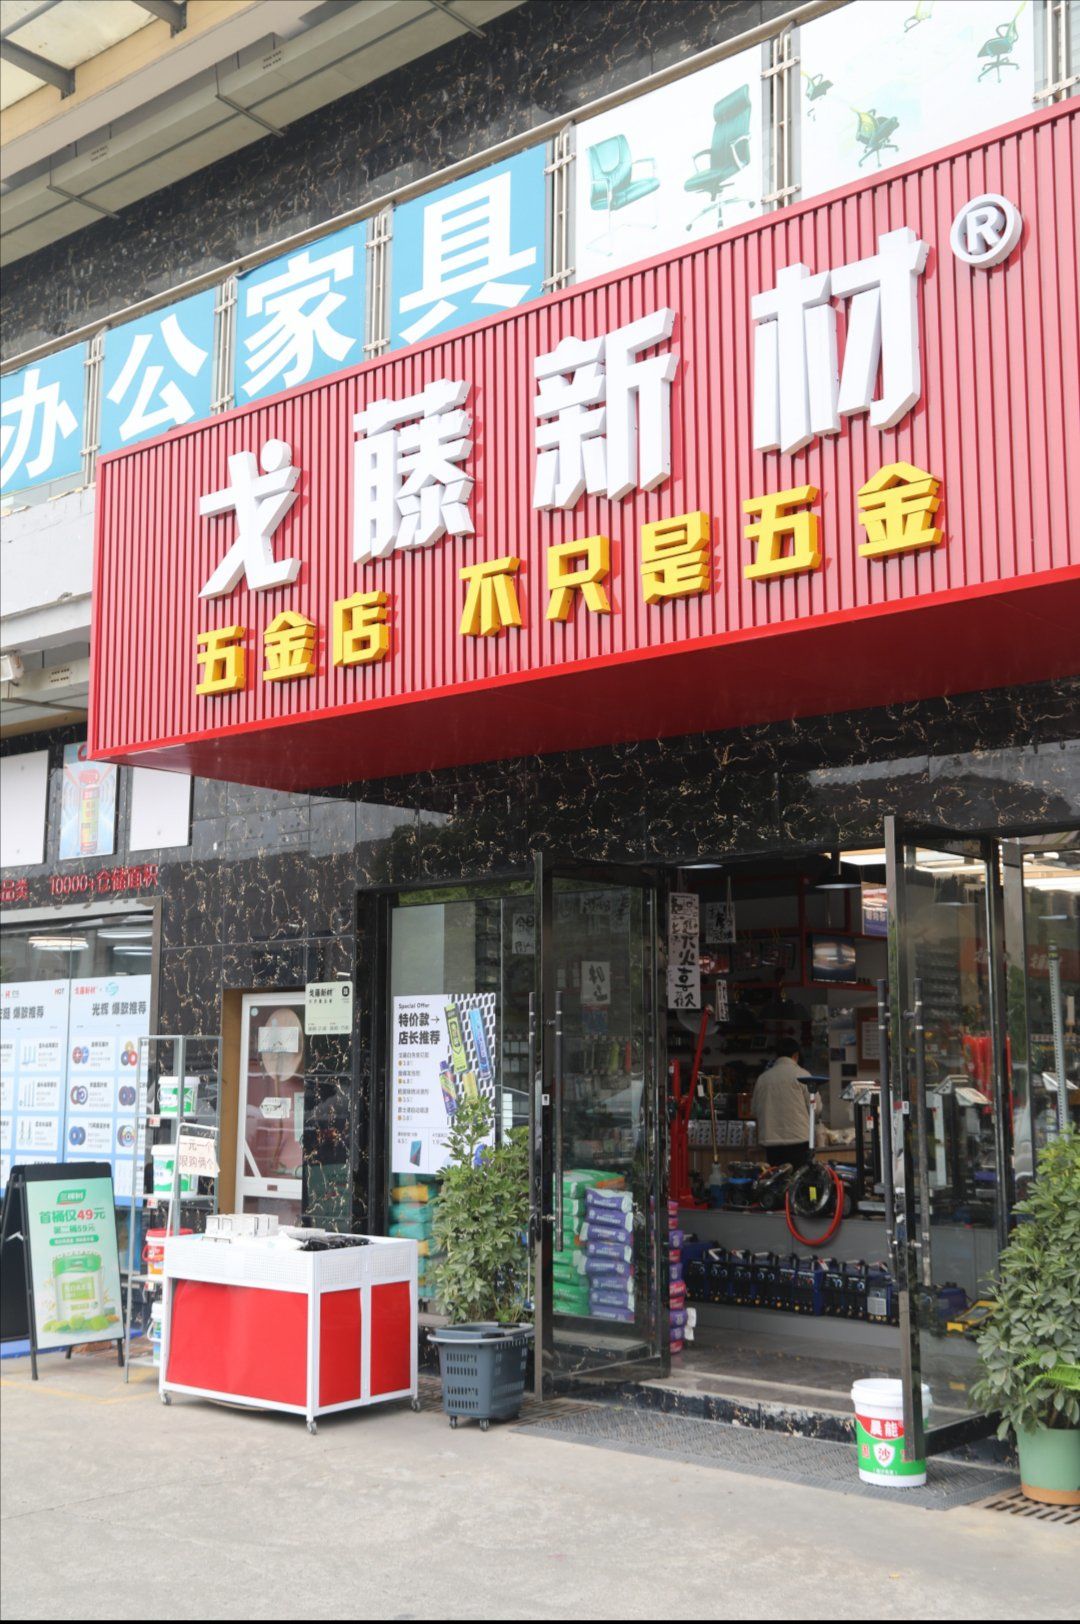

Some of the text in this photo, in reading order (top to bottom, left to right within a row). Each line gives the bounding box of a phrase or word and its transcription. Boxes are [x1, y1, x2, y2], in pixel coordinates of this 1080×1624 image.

[0, 171, 537, 487] 办公家具
[197, 226, 930, 601] 戈藤新材
[196, 461, 944, 698] 五金店 不只是五金
[112, 1001, 147, 1015] 爆款推荐
[398, 1013, 430, 1028] 特价款
[398, 1030, 441, 1045] 店长推荐
[39, 1207, 106, 1224] 首桶仅49元
